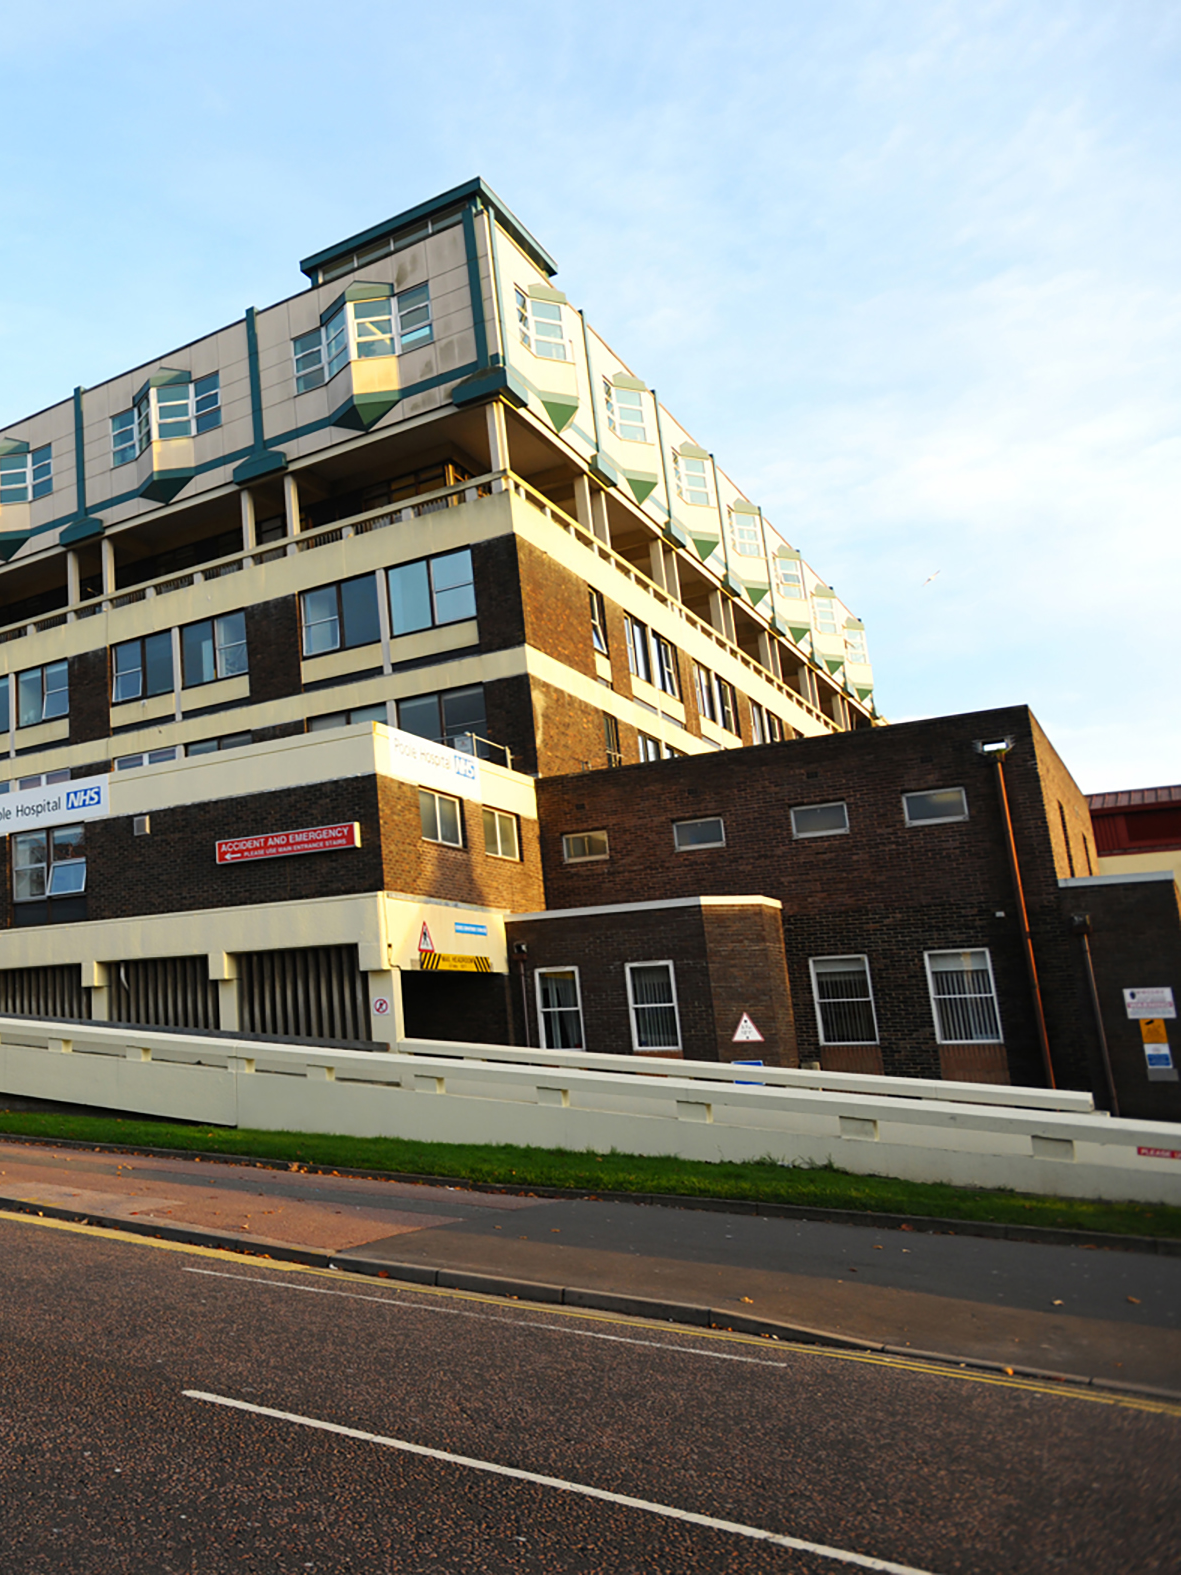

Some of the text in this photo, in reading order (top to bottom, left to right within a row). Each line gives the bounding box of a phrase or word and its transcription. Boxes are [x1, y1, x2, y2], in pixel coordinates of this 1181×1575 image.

[394, 737, 475, 779] Poole Hospital NHS
[16, 796, 61, 818] Hospital
[67, 787, 100, 809] NHS
[221, 827, 349, 852] ACCIDENT AND EMERGENCY
[243, 849, 265, 858] PLEASE
[293, 842, 324, 851] ENTRANCE
[325, 838, 347, 846] STAIRS
